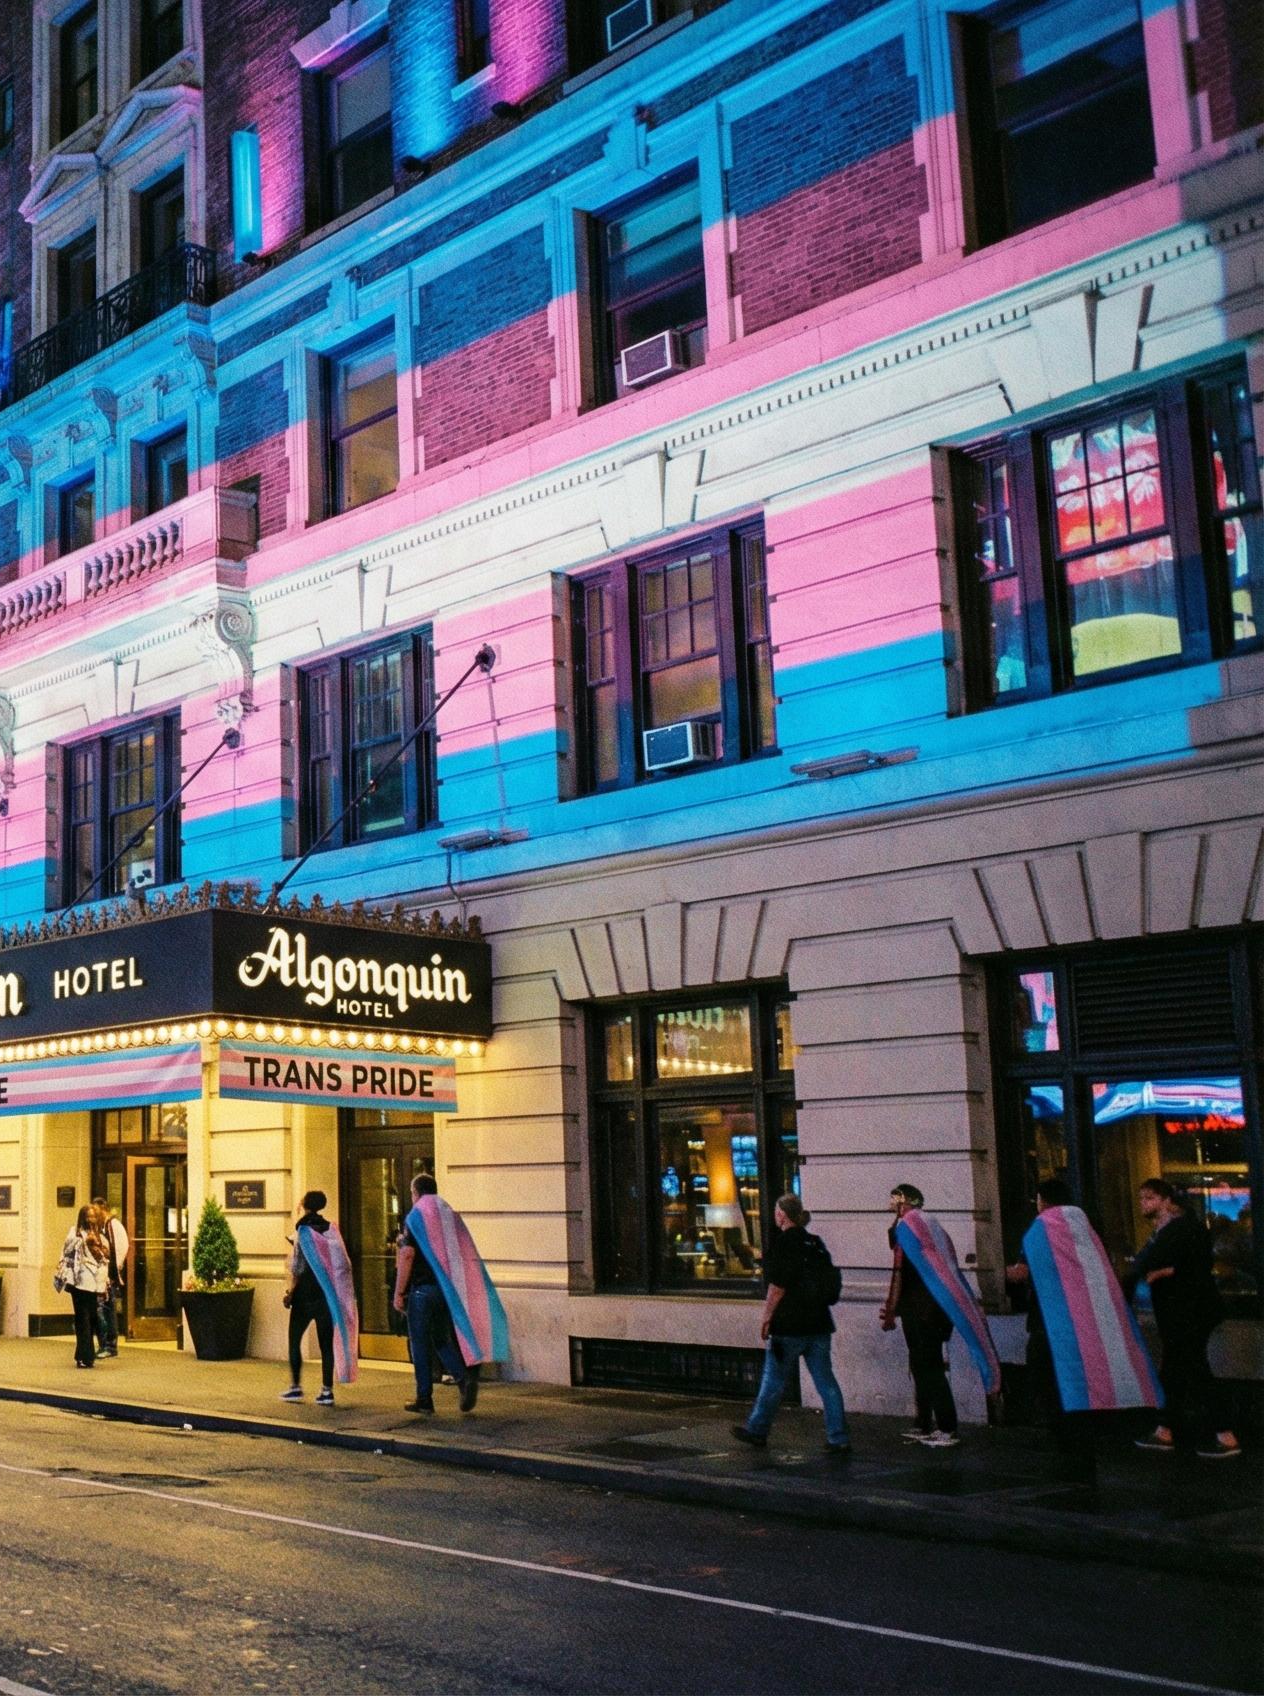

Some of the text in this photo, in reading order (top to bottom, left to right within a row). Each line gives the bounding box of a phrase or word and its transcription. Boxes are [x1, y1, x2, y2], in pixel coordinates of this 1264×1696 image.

[54, 956, 144, 999] HOTEL
[238, 926, 472, 1013] Algonquin
[336, 998, 394, 1019] HOTEL
[243, 1056, 435, 1098] TRANS PRIDE
